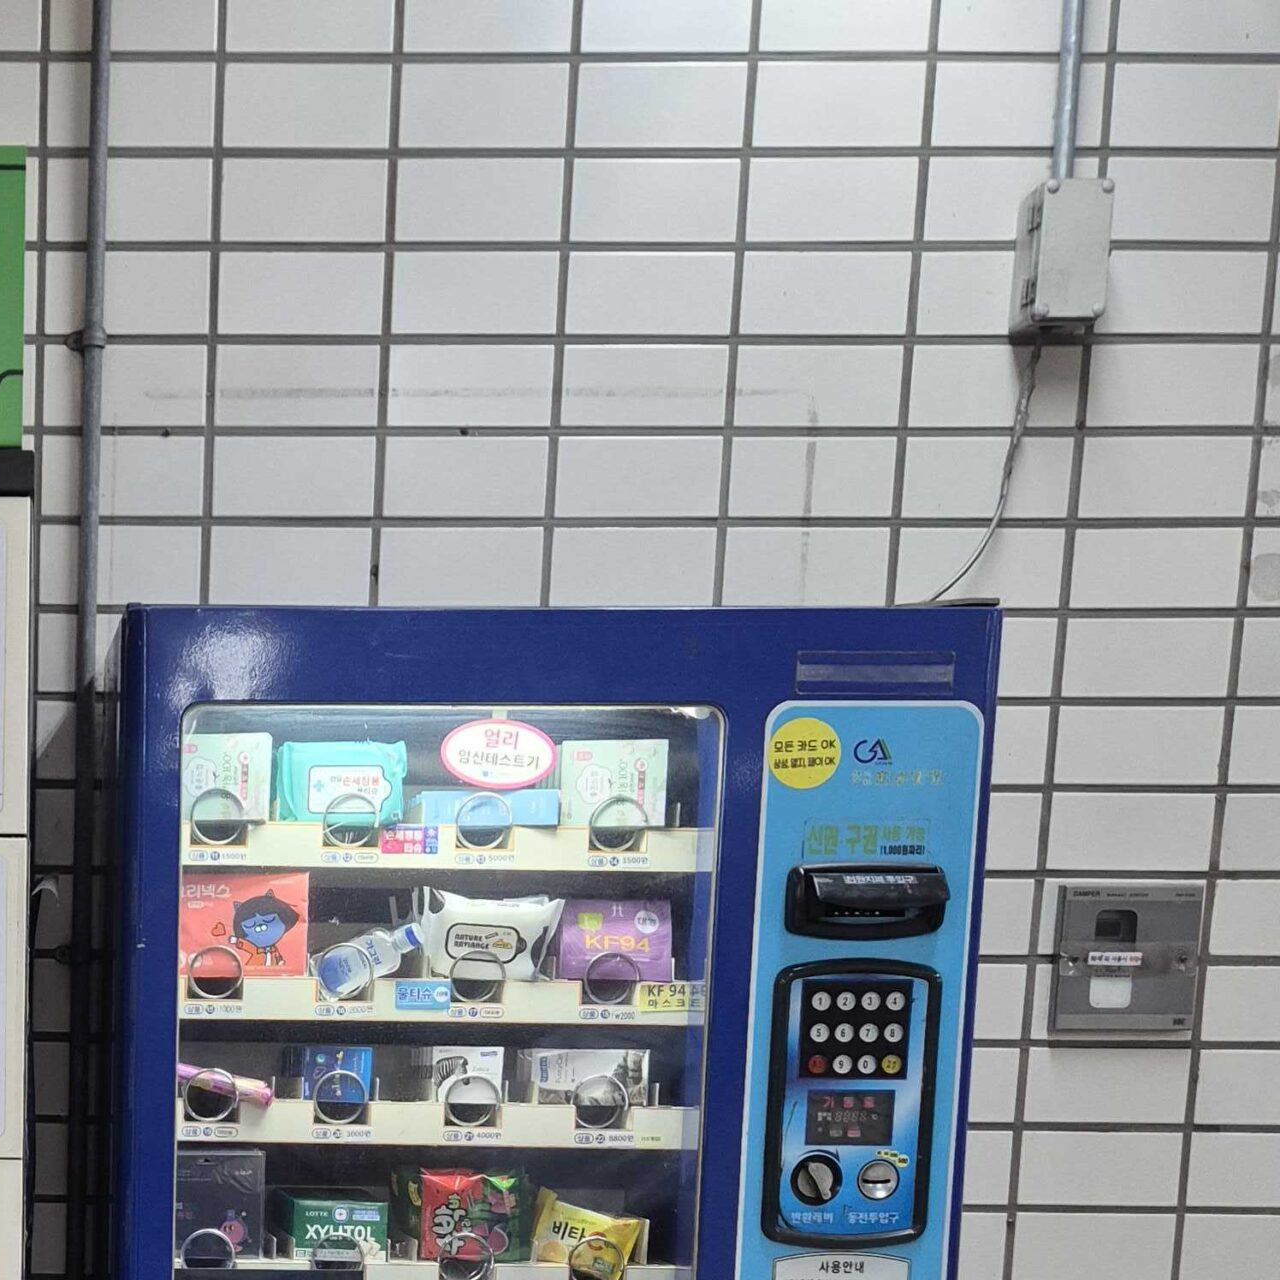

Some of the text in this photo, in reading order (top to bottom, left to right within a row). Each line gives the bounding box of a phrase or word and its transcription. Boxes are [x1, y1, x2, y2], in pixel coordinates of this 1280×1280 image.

[484, 729, 519, 750] 얼리
[773, 740, 836, 753] 모든 카드 OK
[458, 749, 541, 770] 임신테스트기
[585, 935, 650, 952] KF94
[397, 987, 433, 1001] 물티슈
[648, 984, 686, 997] KF 94
[819, 1261, 865, 1274] 사용안내
